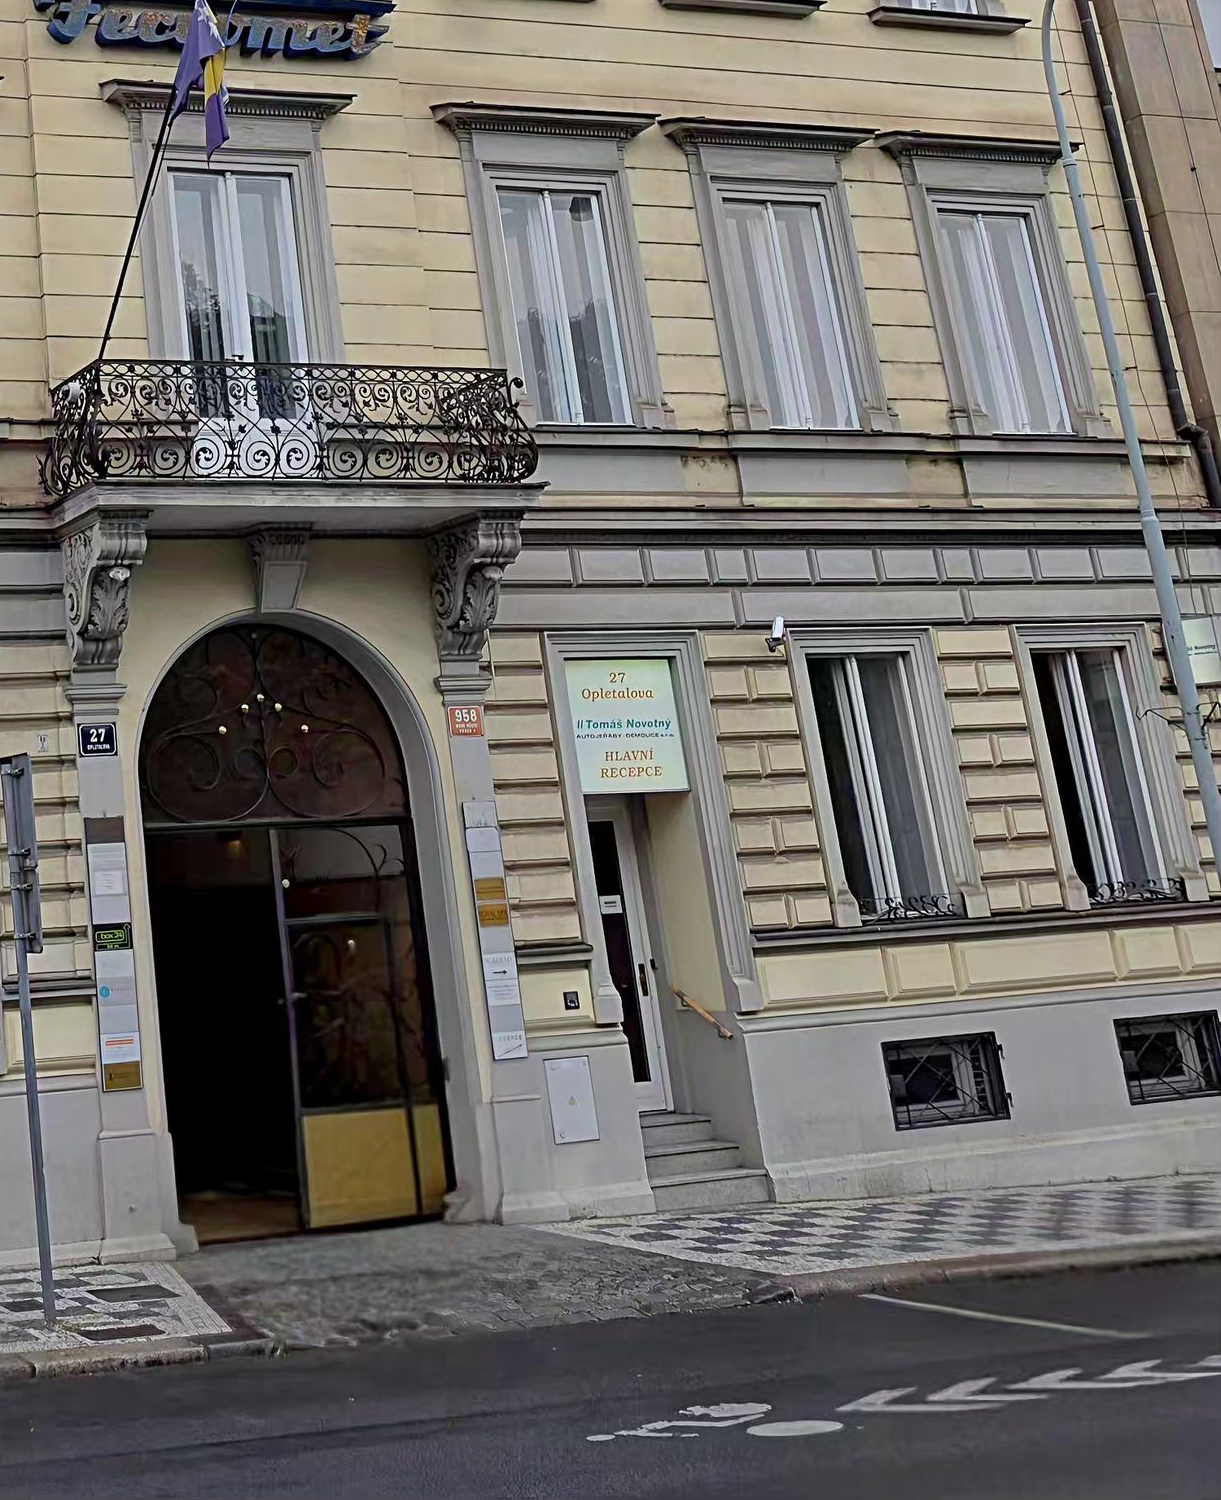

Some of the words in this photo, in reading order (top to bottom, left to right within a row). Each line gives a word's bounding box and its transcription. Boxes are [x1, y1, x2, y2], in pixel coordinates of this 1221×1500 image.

[609, 672, 626, 684] 27
[581, 687, 654, 702] Opletalova
[455, 709, 477, 722] 958
[626, 717, 671, 730] Novotný
[89, 729, 106, 742] 27
[605, 748, 654, 762] HLAVNÍ
[600, 766, 662, 778] RECEPCE
